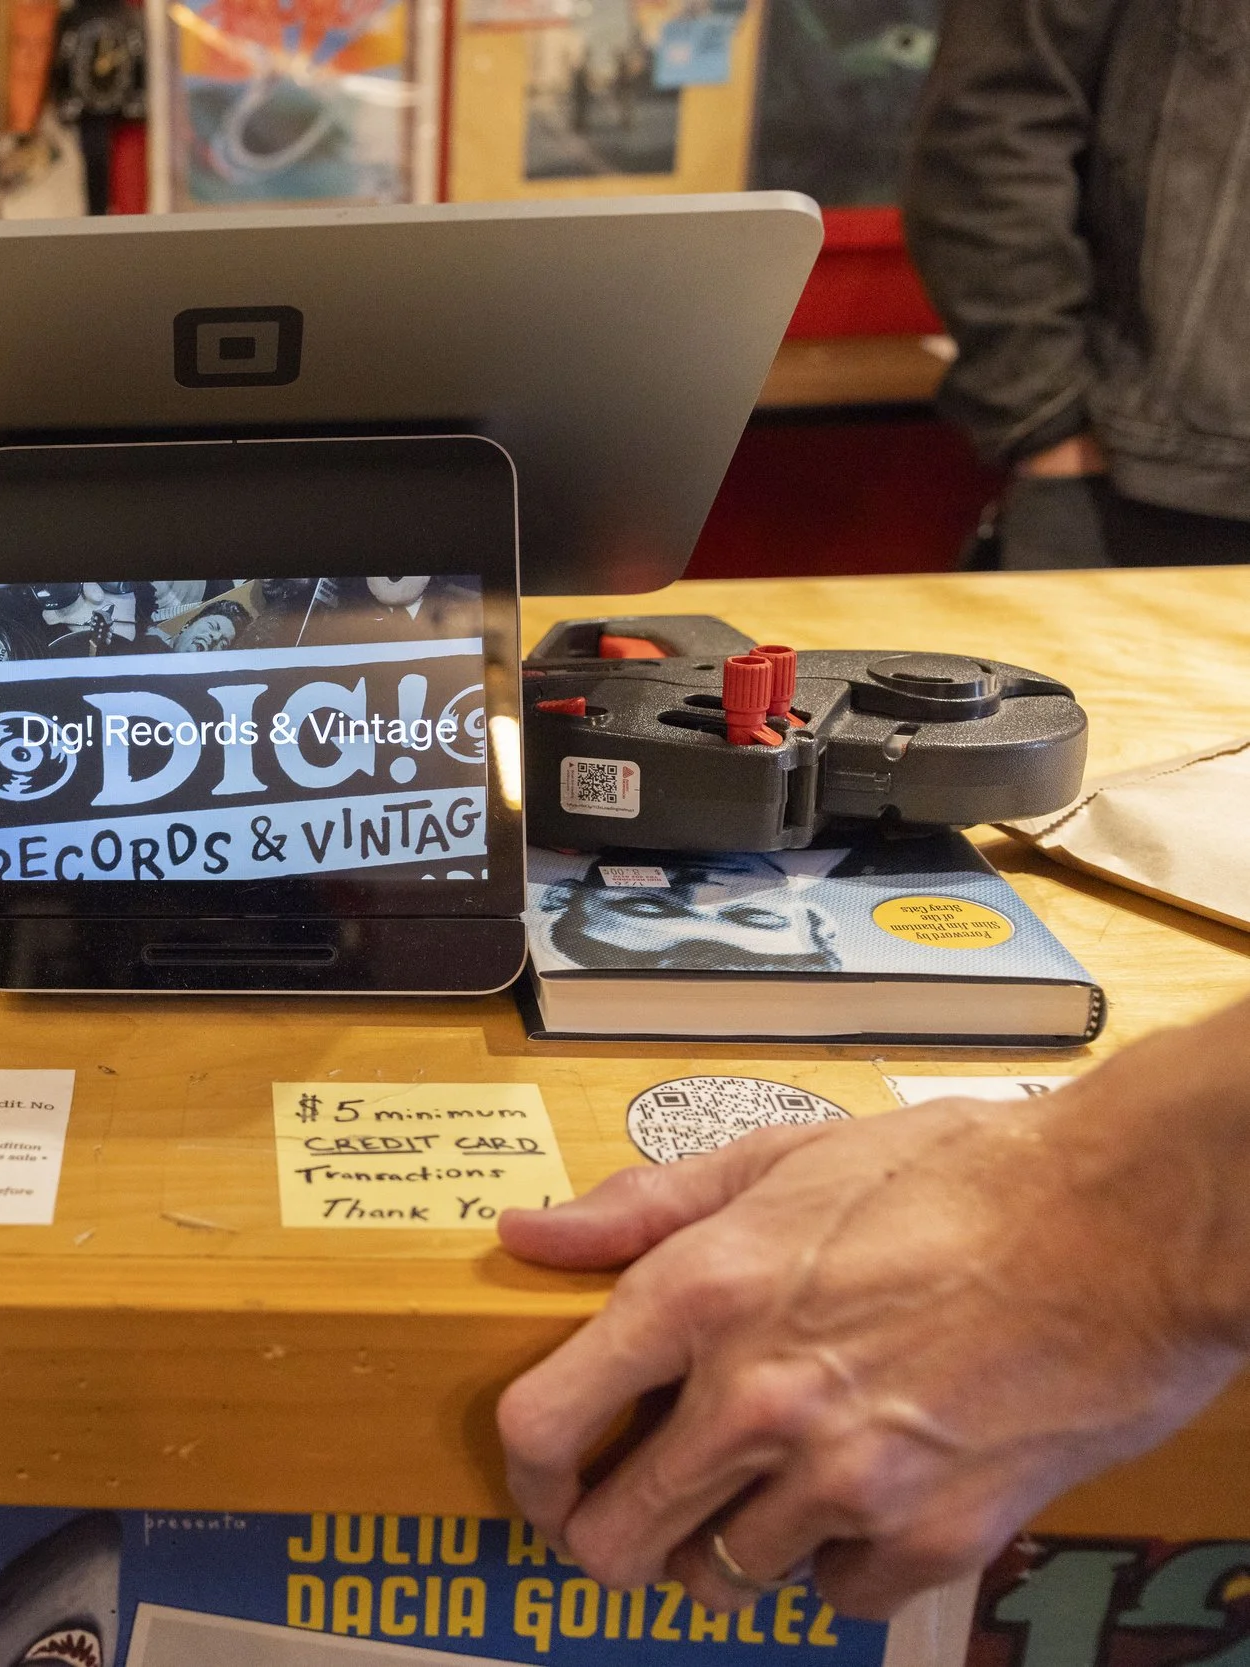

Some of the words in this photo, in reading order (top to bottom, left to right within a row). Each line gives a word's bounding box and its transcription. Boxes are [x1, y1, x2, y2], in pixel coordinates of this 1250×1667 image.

[22, 714, 94, 752] Dig!
[106, 712, 259, 747] Records
[269, 712, 298, 743] &
[308, 711, 458, 751] Vintage
[82, 672, 428, 807] DIG!
[250, 815, 288, 863] &
[301, 797, 487, 863] VINTAG
[900, 905, 927, 914] Cats
[930, 903, 962, 913] Stray
[920, 914, 940, 923] the
[942, 914, 954, 922] of
[890, 922, 945, 933] Phantom
[946, 921, 968, 931] Jim
[971, 920, 1000, 931] Slim
[916, 931, 930, 941] by
[931, 930, 992, 941] Foreword
[31, 1102, 55, 1111] No
[373, 1107, 527, 1121] minimum
[304, 1134, 441, 1153] CREDIT
[454, 1136, 540, 1153] CARD
[7, 1153, 38, 1162] sale
[295, 1165, 506, 1184] Transactions
[322, 1197, 430, 1221] Thank
[287, 1513, 480, 1566] JULIO
[287, 1574, 487, 1638] DACIA
